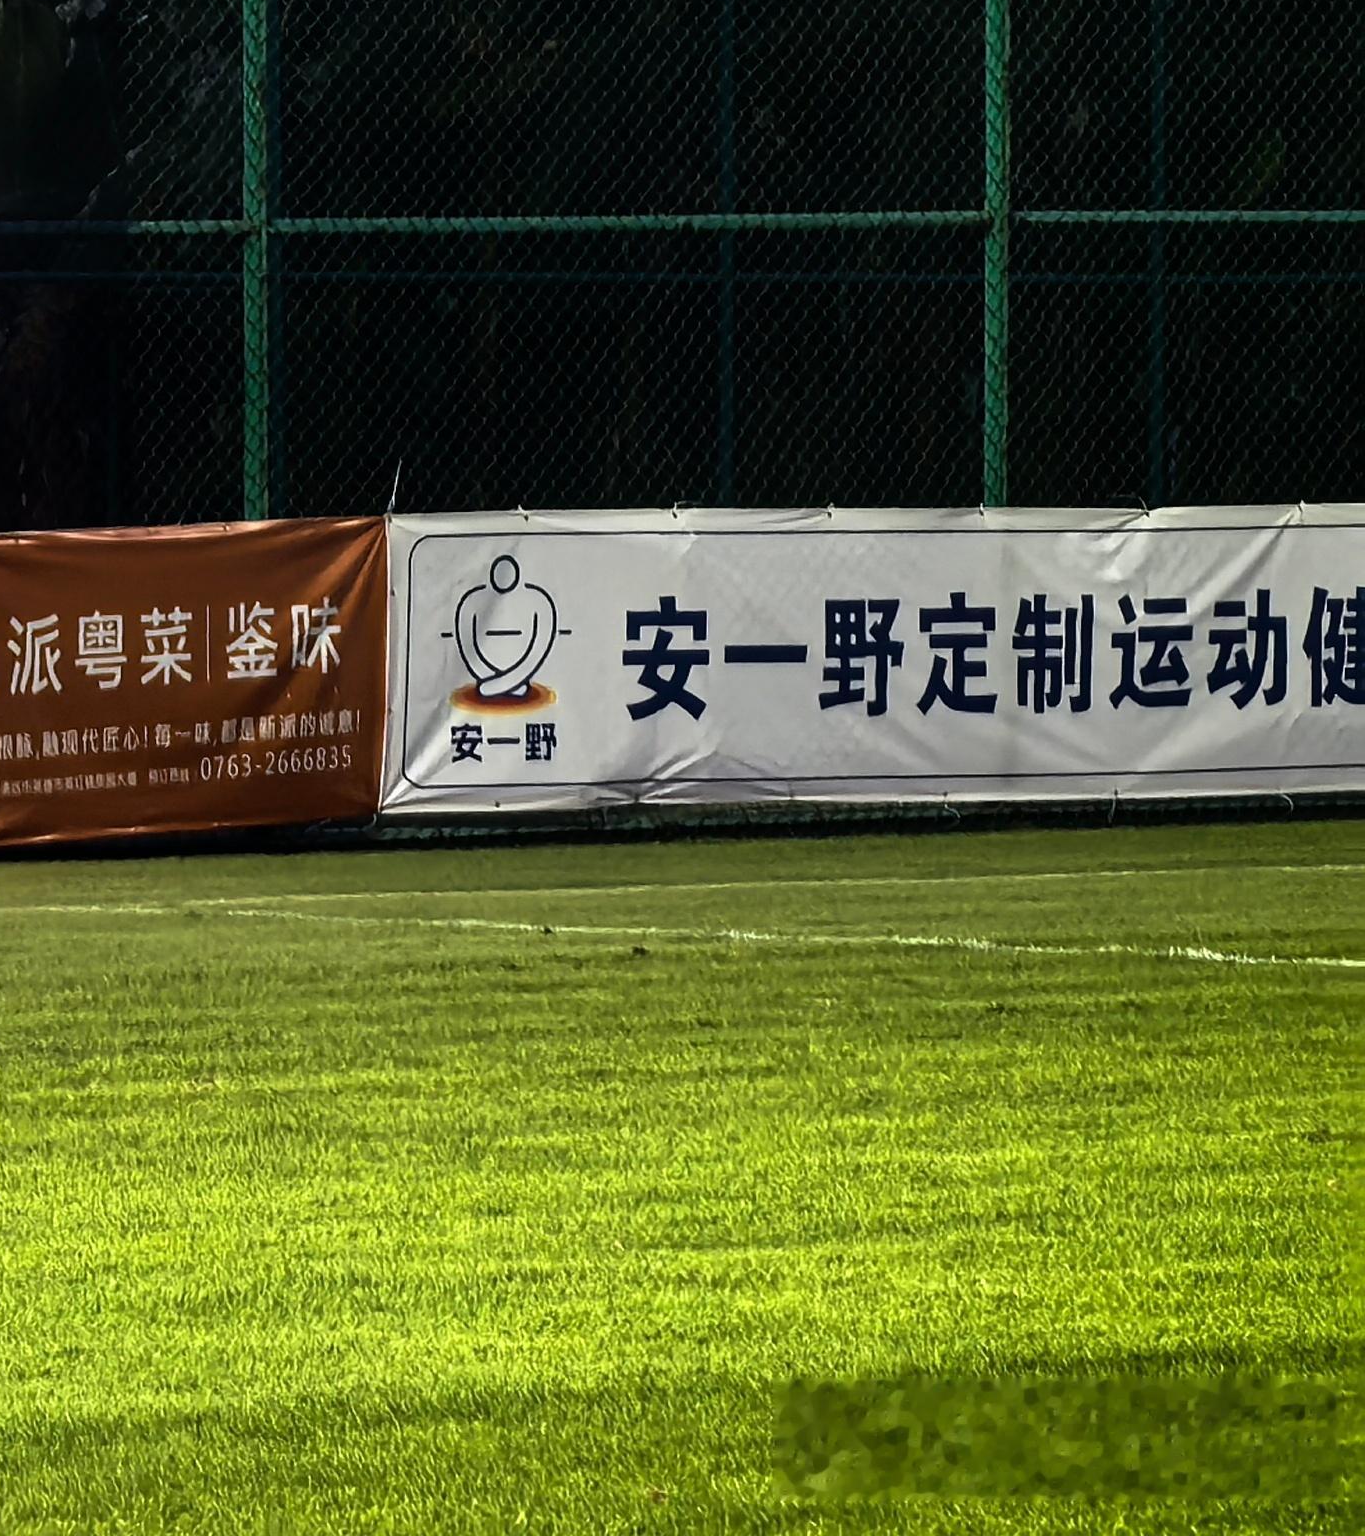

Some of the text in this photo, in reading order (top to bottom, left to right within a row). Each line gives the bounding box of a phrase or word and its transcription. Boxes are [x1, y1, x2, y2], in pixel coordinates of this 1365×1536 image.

[225, 596, 343, 680] 鉴味
[621, 585, 1365, 722] 安一野定制运动健
[200, 744, 352, 781] 0763-2666835
[450, 722, 558, 763] 安一野
